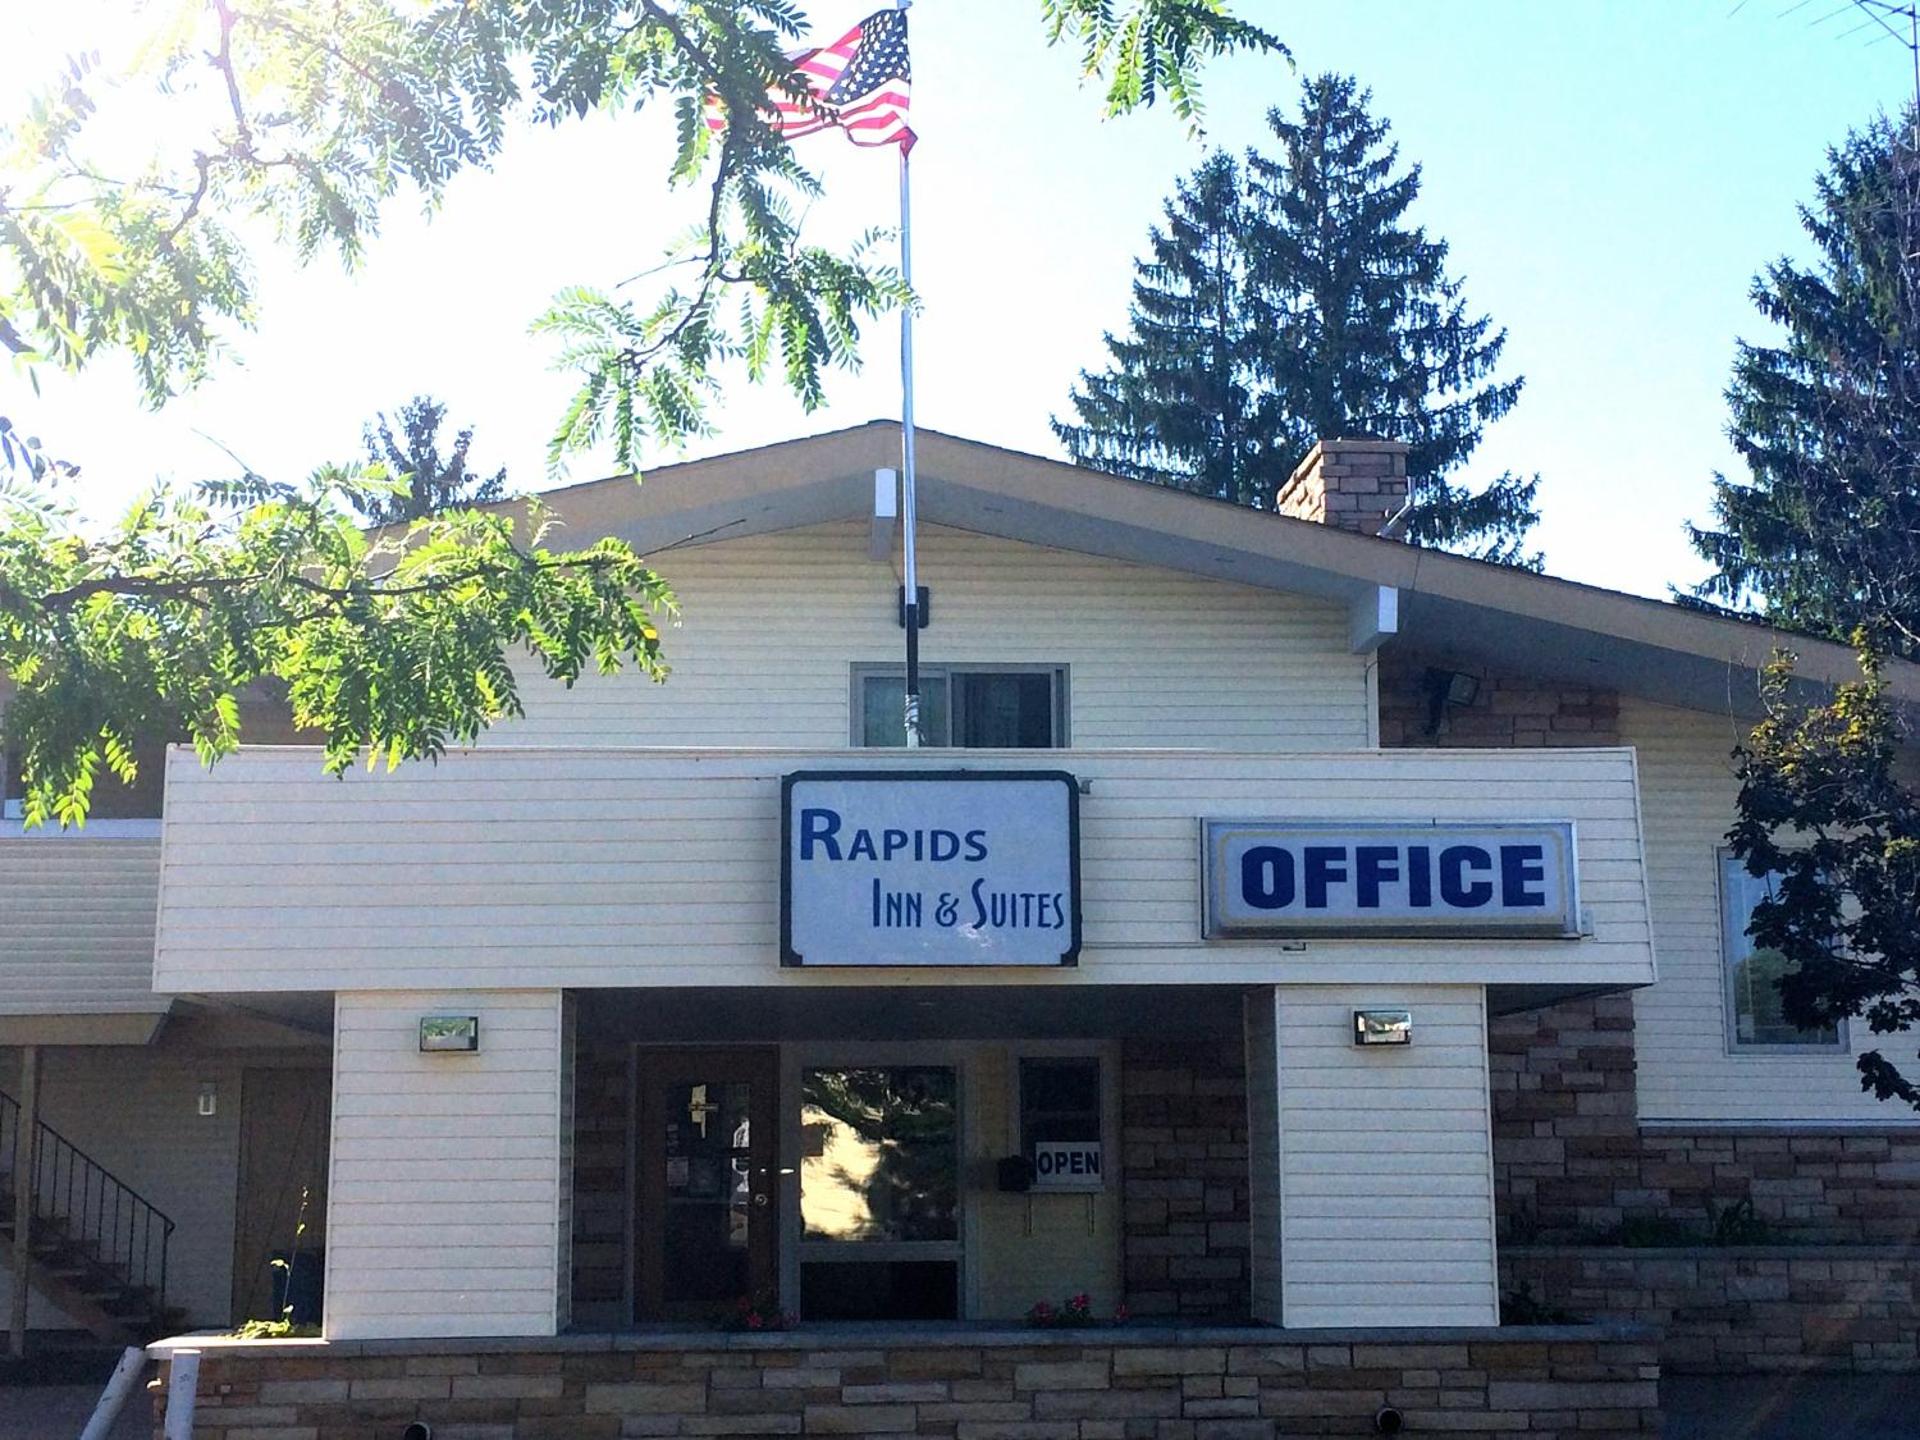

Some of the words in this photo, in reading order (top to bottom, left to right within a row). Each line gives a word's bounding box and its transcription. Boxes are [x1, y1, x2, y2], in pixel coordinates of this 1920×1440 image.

[1241, 845, 1546, 910] OFFICE
[934, 892, 960, 928] &
[1037, 1151, 1100, 1175] OPEN
